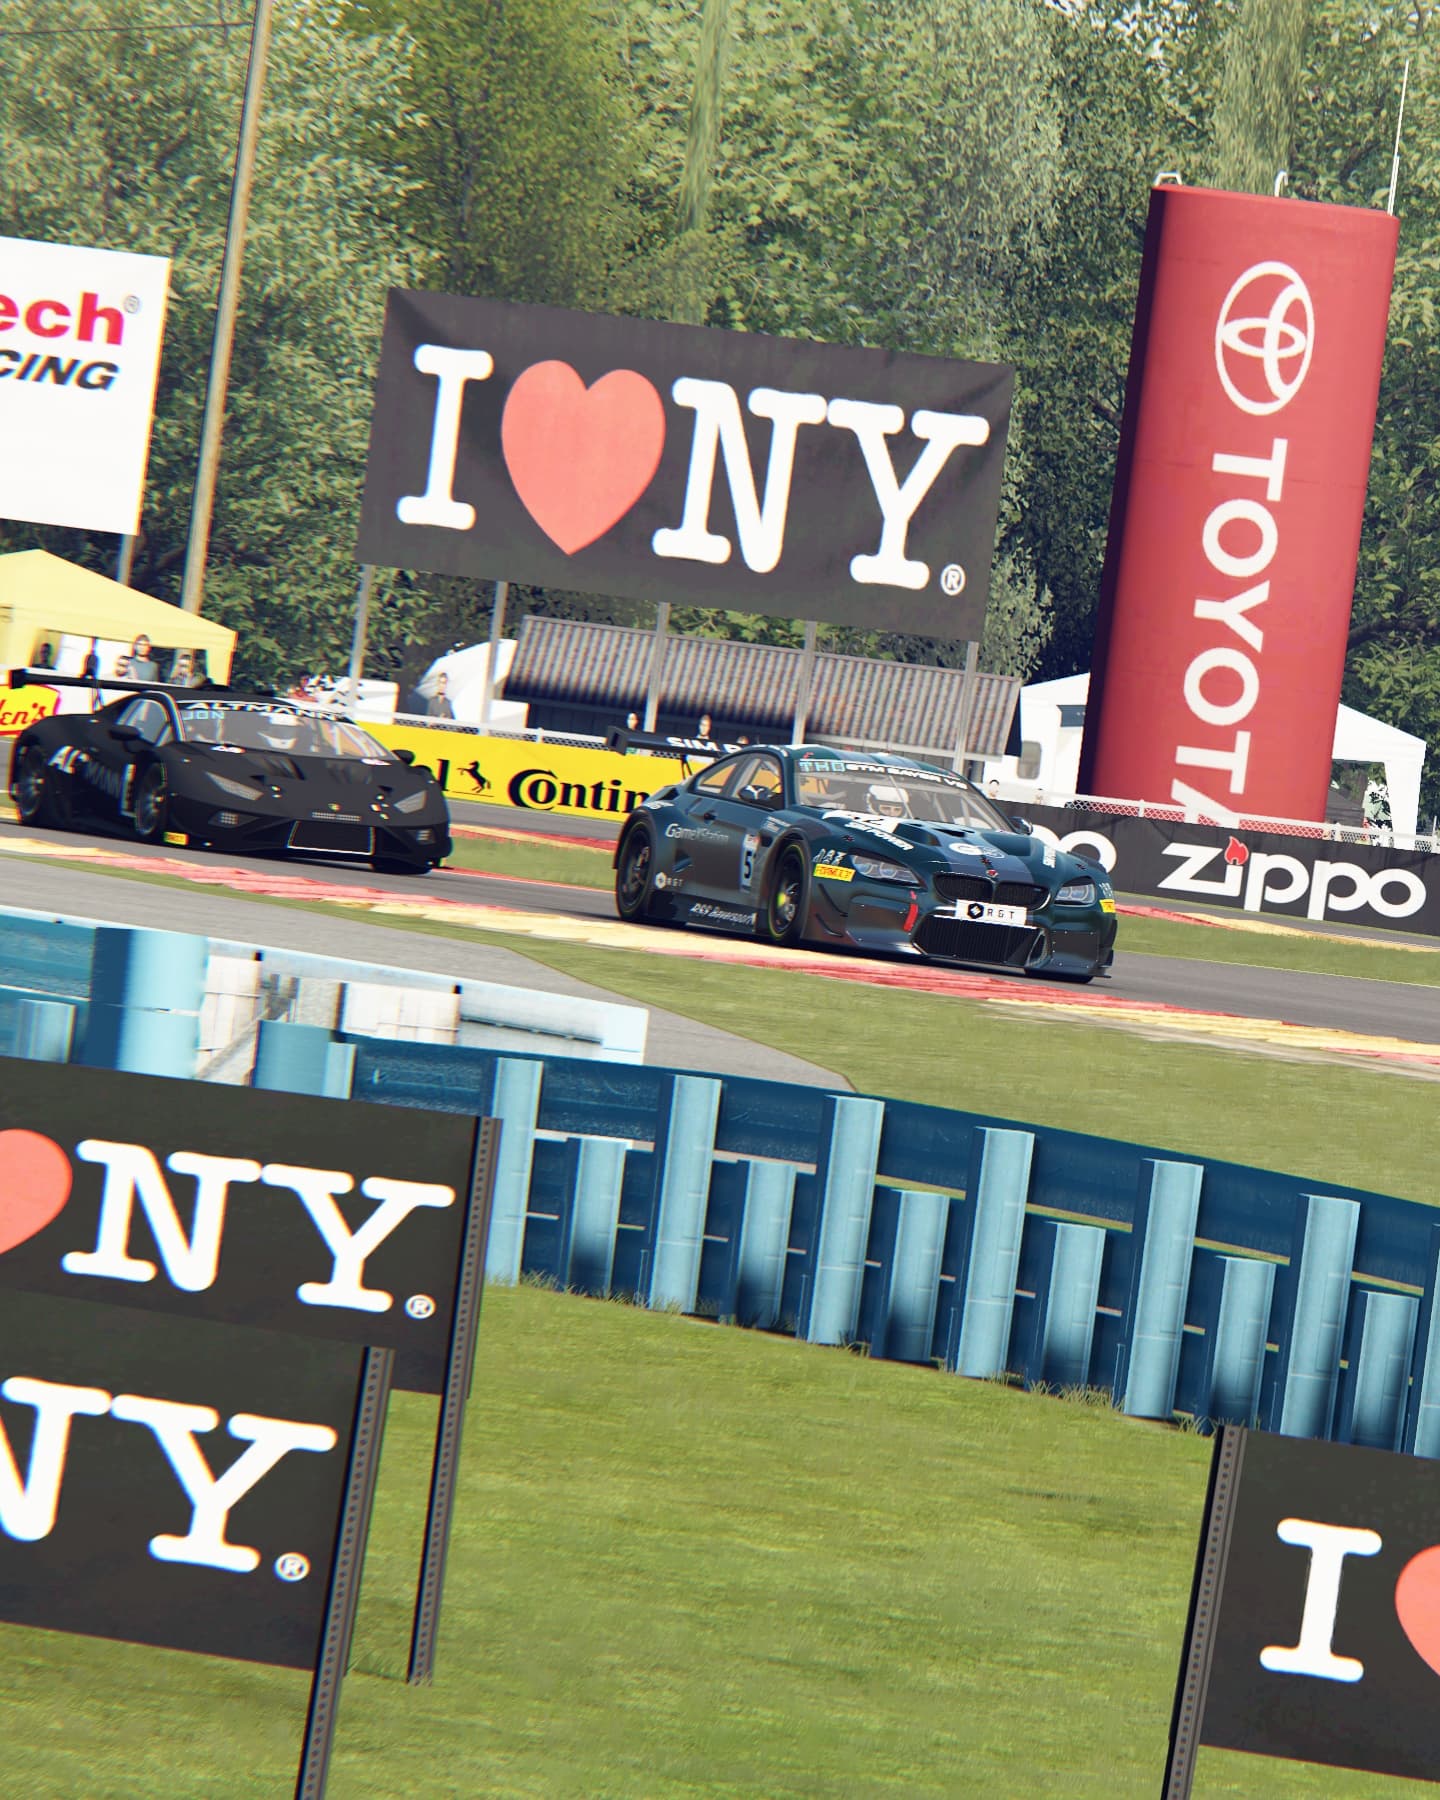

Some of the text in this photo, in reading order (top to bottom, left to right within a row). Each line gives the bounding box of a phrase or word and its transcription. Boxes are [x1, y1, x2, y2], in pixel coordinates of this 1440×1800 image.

[396, 343, 494, 531] I
[186, 702, 338, 721] ALTMANN
[666, 736, 720, 752] SIM
[1157, 836, 1427, 921] zippo
[1259, 1518, 1383, 1684] I
